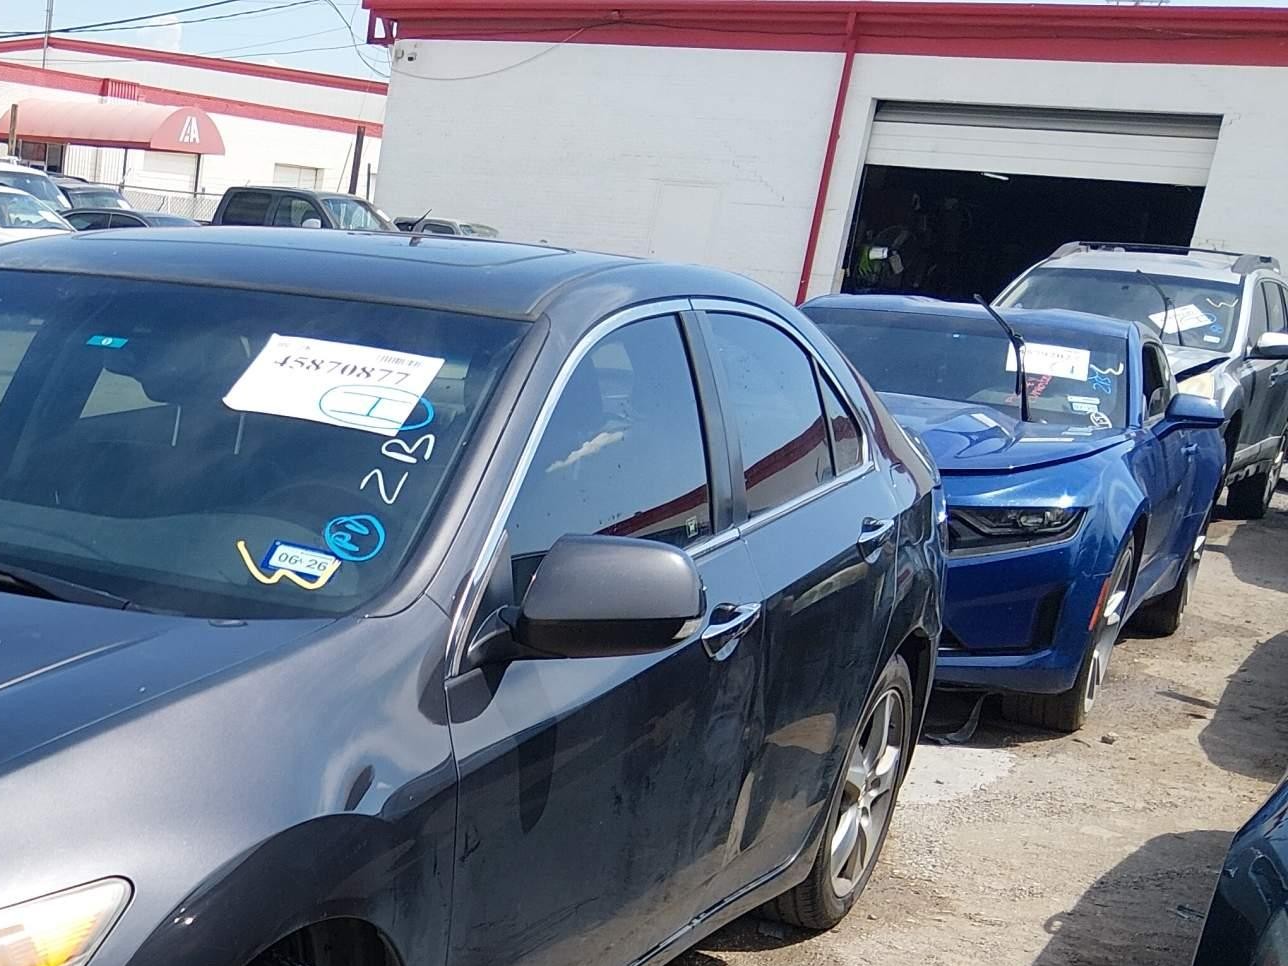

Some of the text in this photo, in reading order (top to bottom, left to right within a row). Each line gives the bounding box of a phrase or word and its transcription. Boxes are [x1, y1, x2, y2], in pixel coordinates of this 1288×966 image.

[274, 354, 411, 385] 45870877
[278, 552, 329, 572] 06 26
